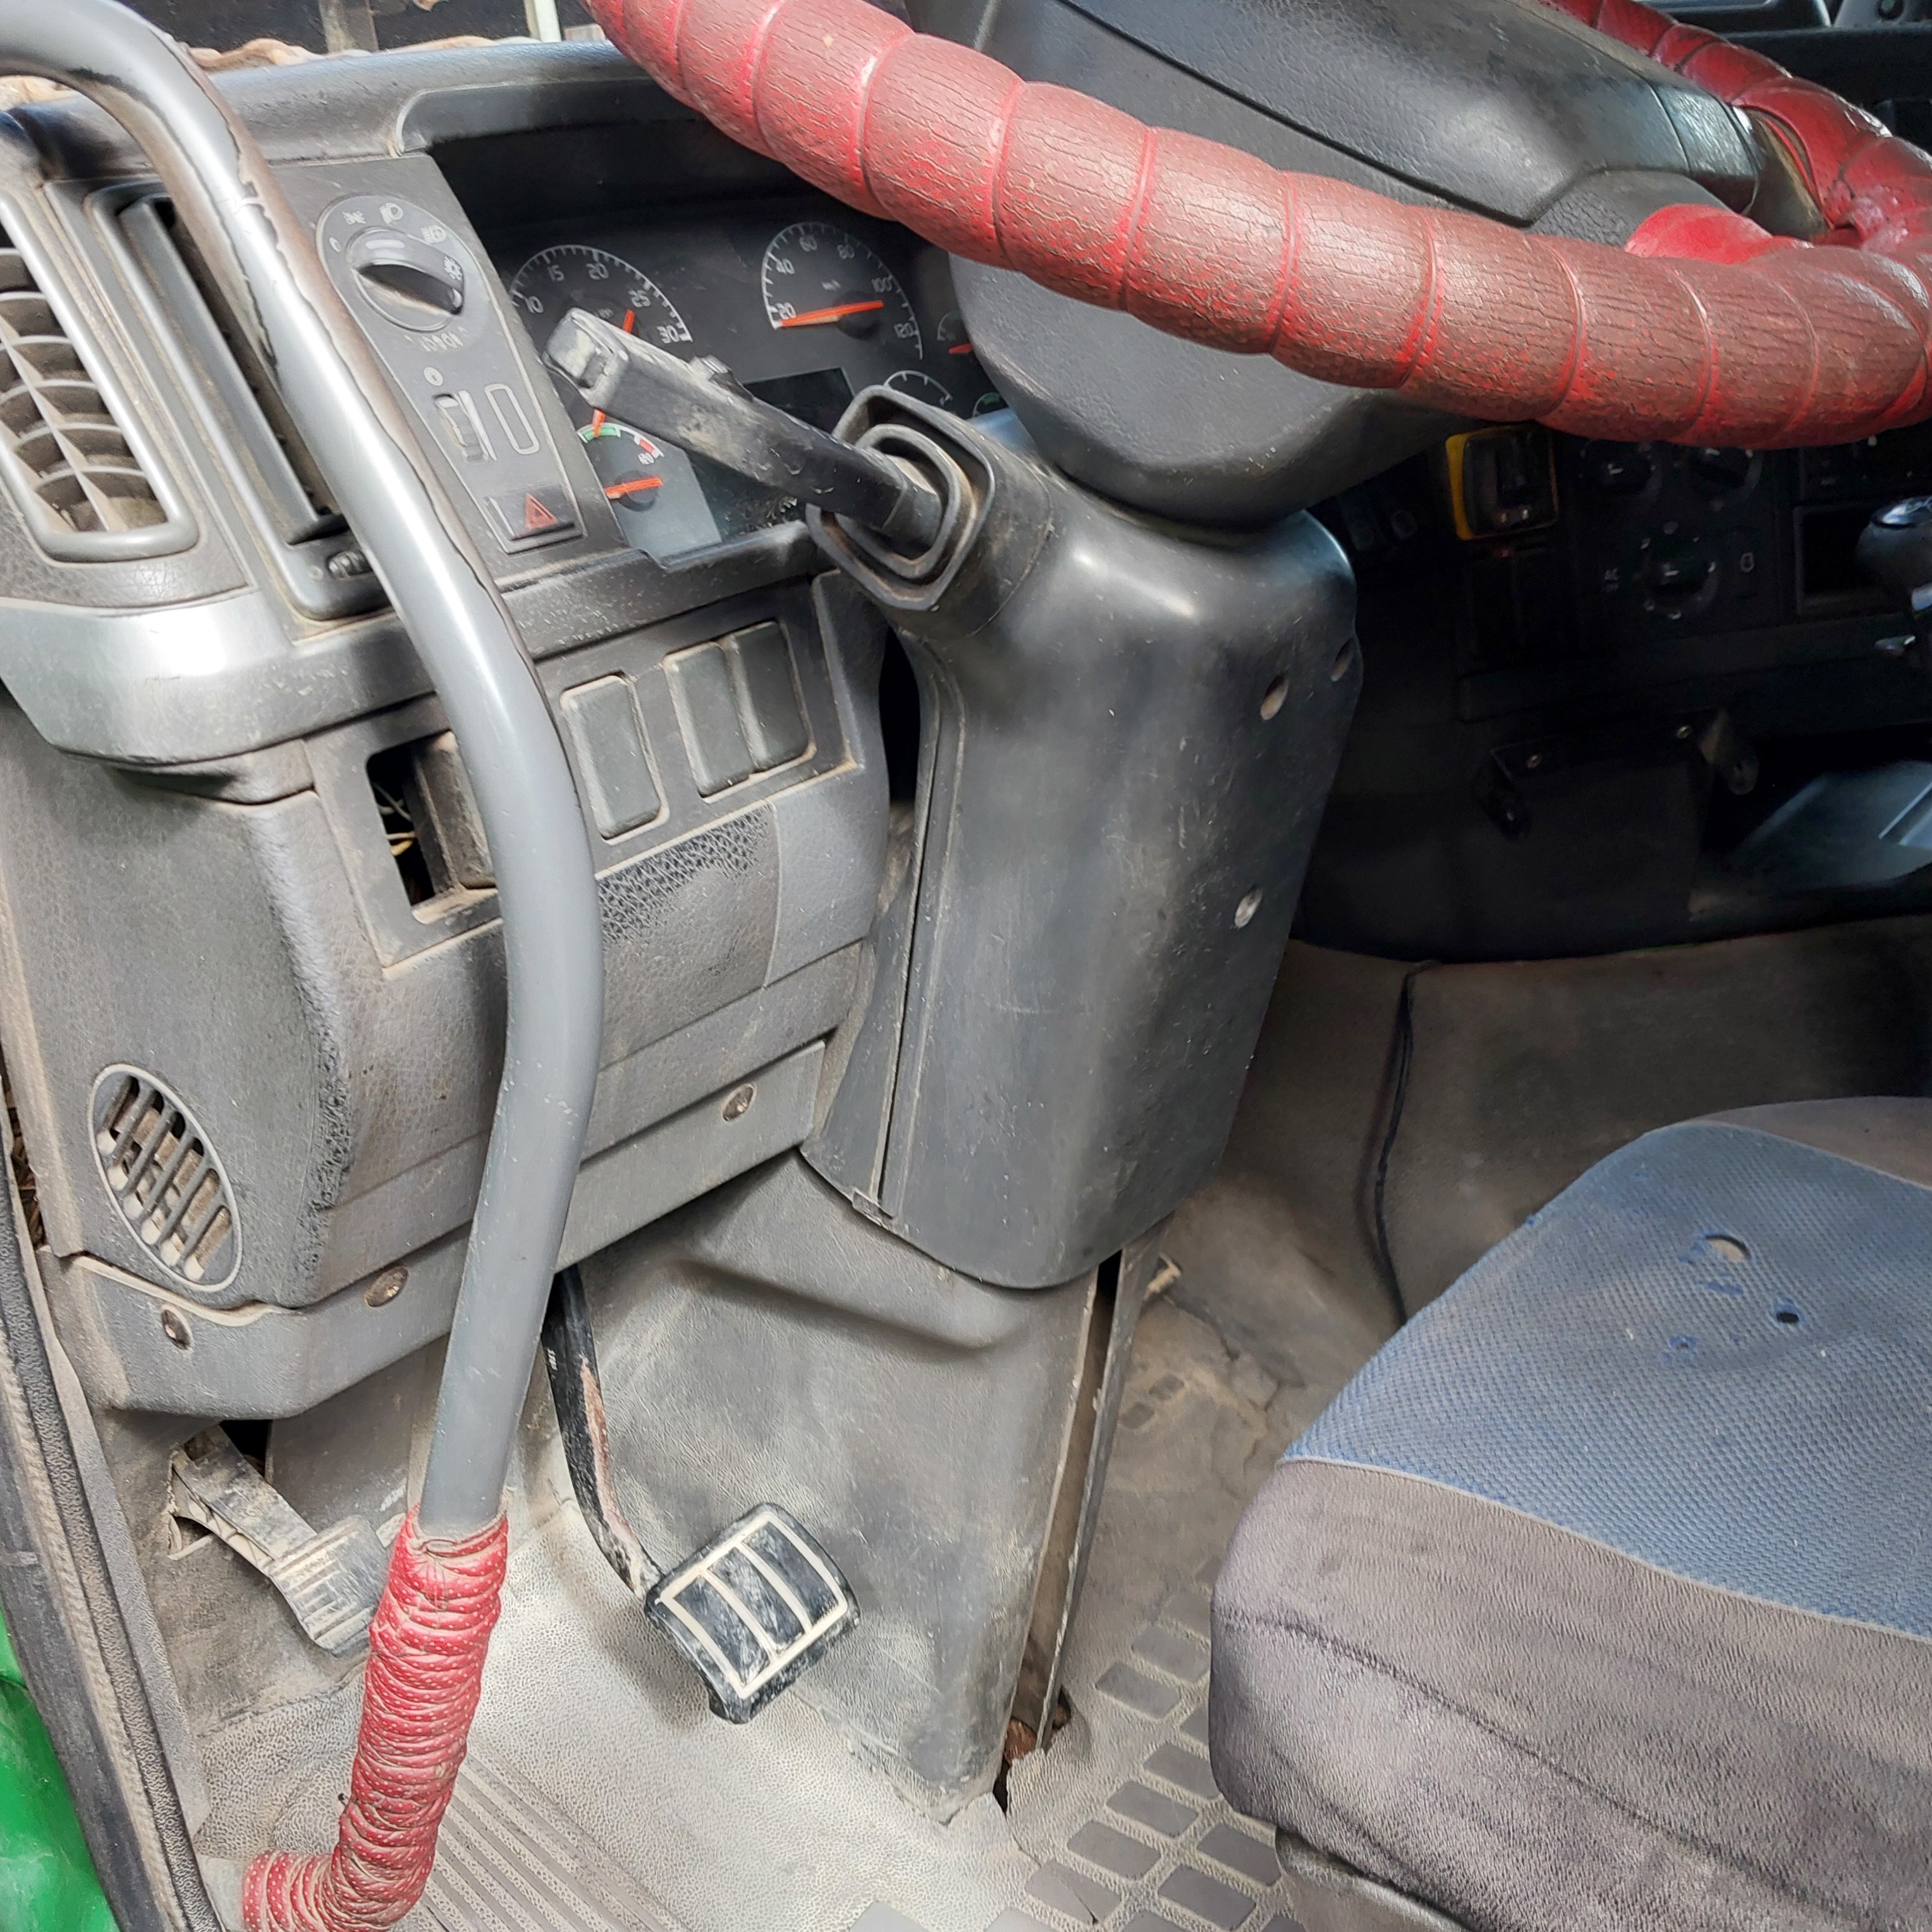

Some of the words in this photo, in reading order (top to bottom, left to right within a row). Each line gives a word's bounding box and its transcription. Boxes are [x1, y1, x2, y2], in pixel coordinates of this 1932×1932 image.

[836, 244, 855, 260] 80
[547, 264, 565, 281] 15
[586, 262, 609, 279] 20
[776, 258, 795, 274] 40
[872, 277, 892, 292] 100
[525, 296, 544, 314] 10
[628, 289, 651, 308] 25
[776, 302, 797, 320] 20
[657, 324, 680, 343] 30
